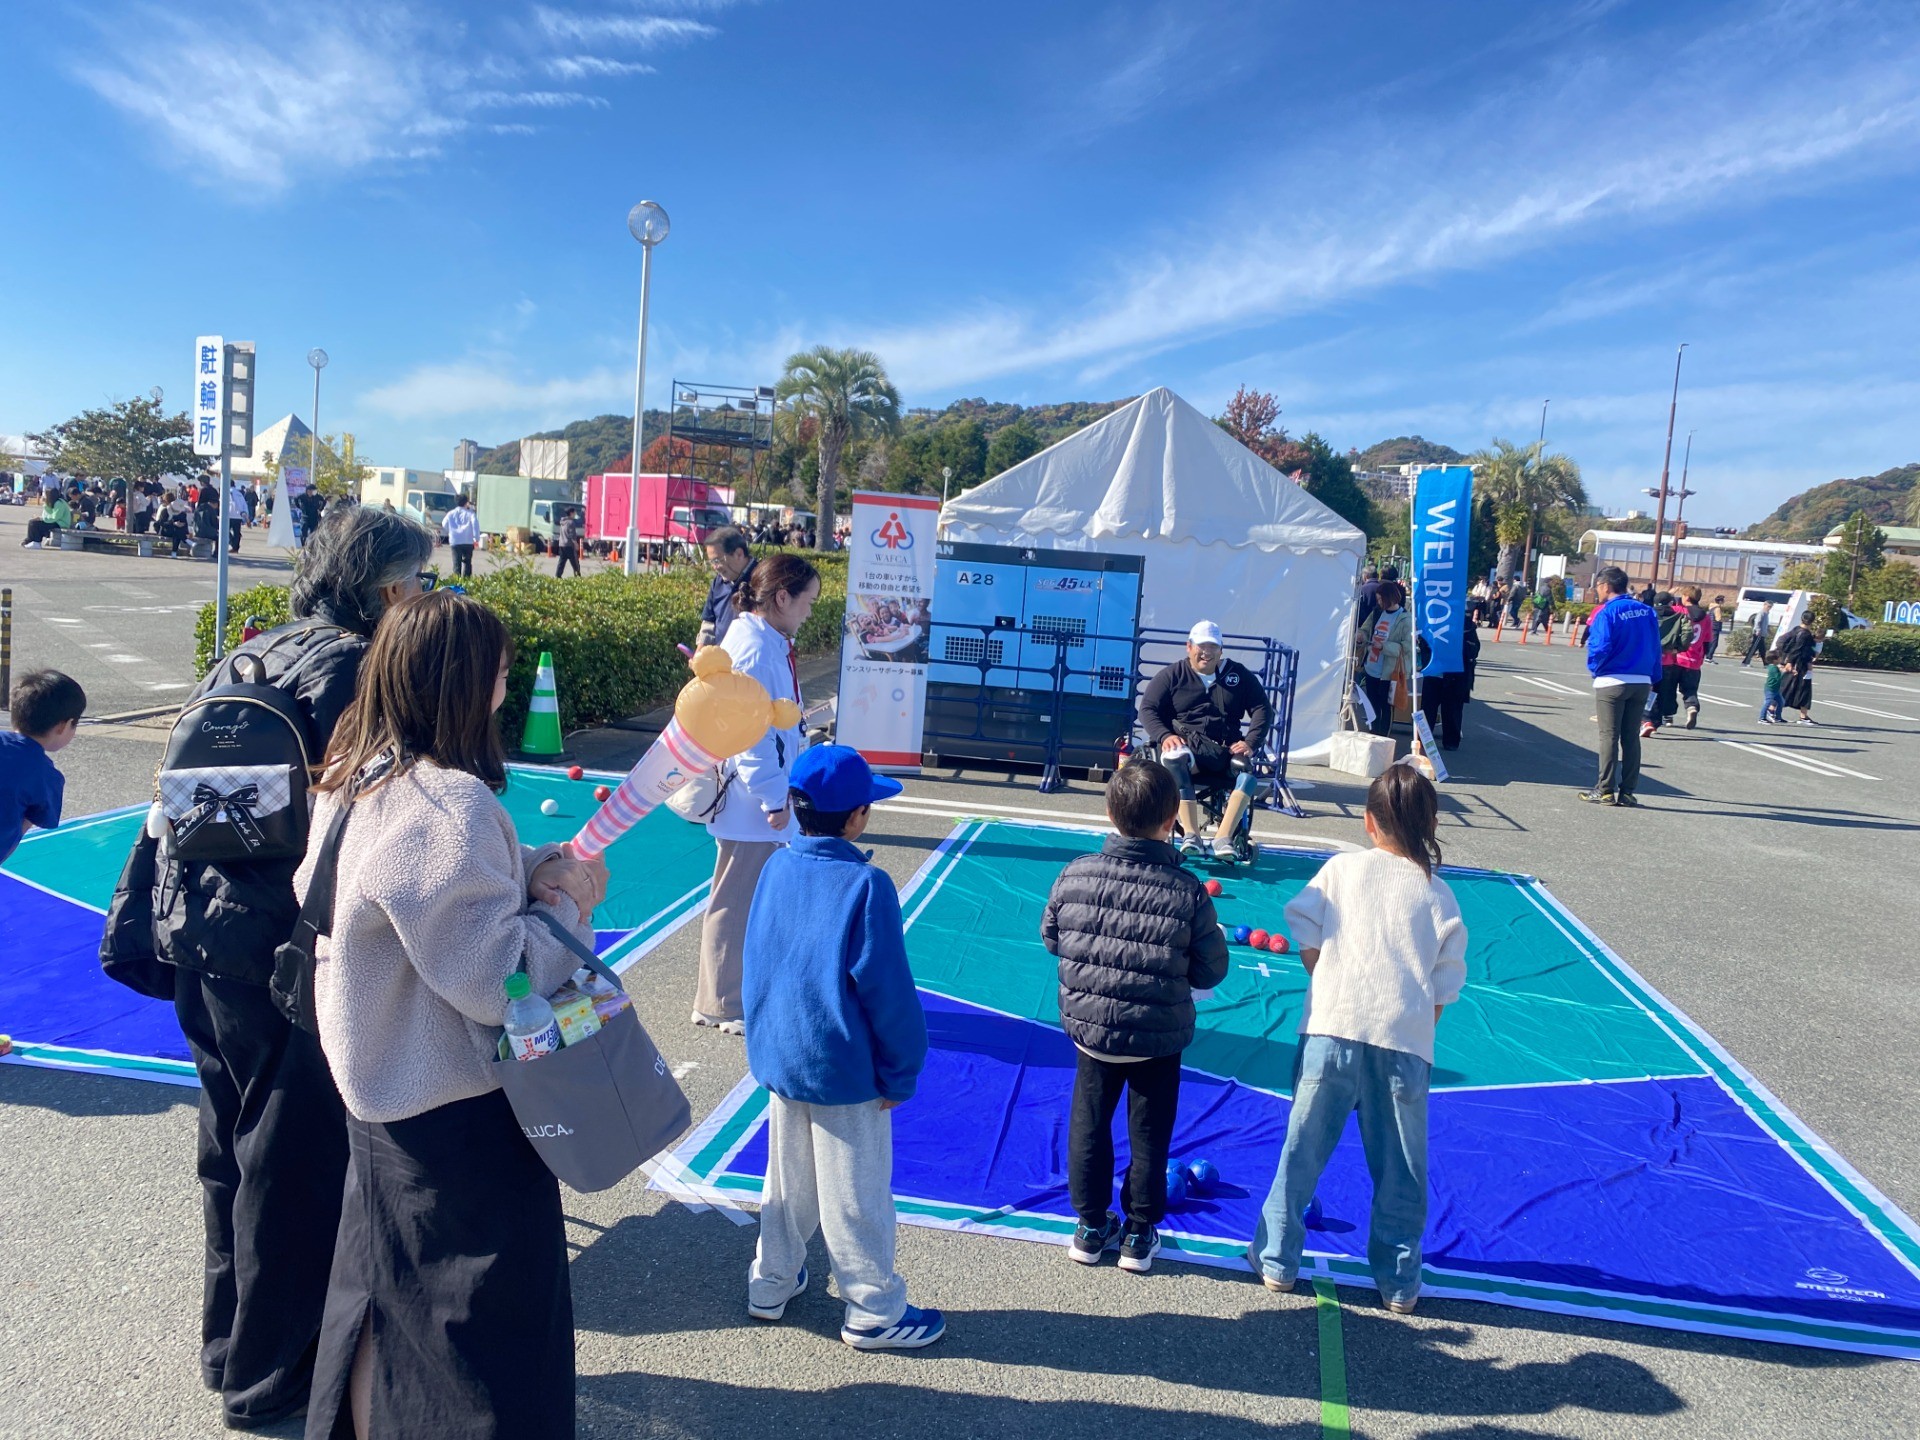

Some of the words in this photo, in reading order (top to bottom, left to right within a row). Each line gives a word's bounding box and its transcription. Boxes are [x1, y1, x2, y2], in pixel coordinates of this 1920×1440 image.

[199, 345, 217, 446] 駐輪所
[875, 553, 908, 564] WAFCA
[865, 571, 918, 583] 1台の車いすから
[959, 572, 994, 586] A28
[859, 582, 922, 593] 移動の自由と希望を
[1056, 577, 1079, 590] 45
[846, 665, 923, 676] マンスリーサポーター募集
